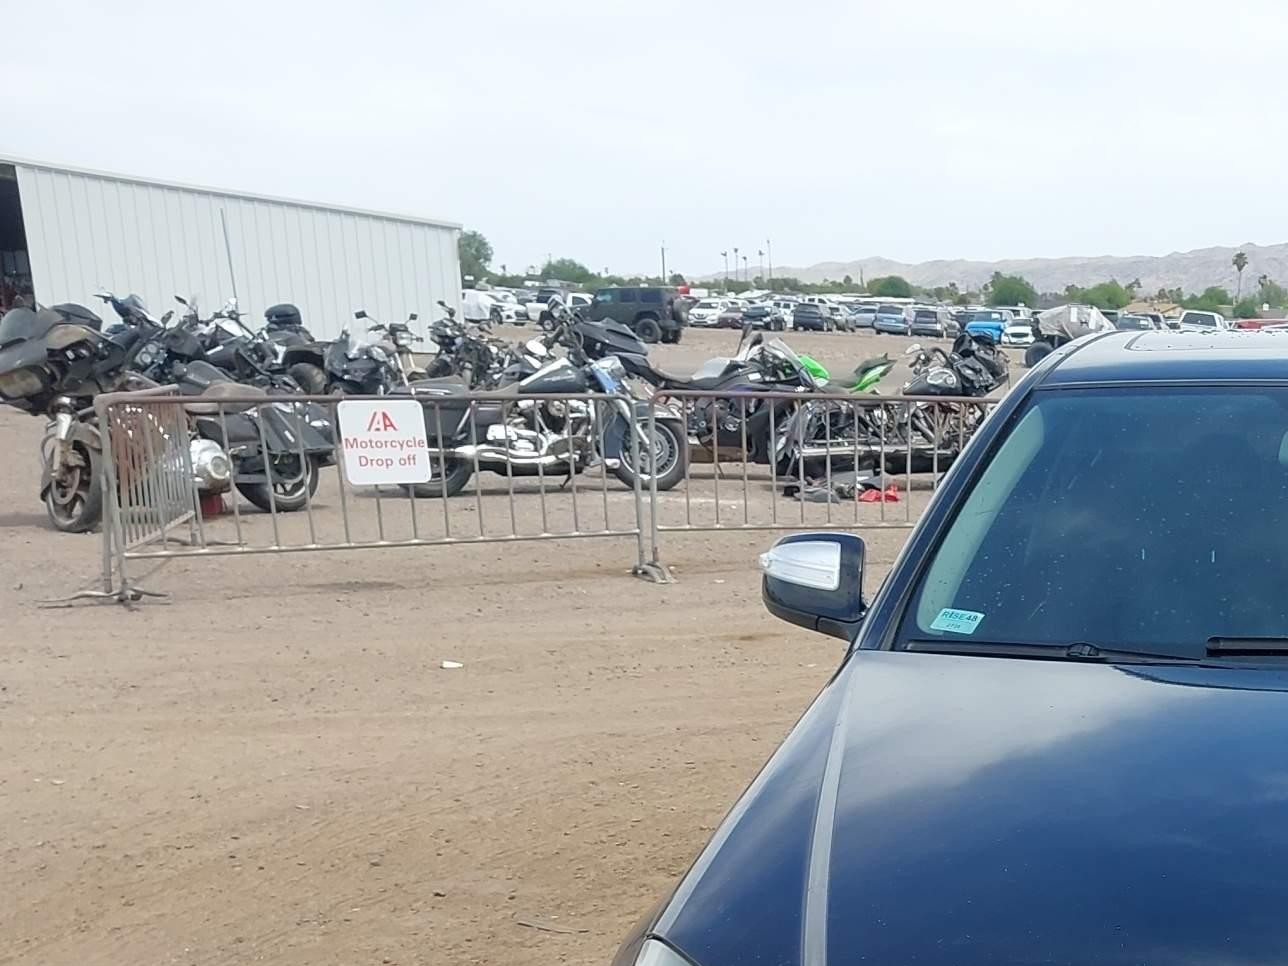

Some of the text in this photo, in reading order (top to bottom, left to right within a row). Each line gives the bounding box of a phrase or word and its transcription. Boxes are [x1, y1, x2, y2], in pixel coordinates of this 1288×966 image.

[345, 437, 425, 450] Motorcycle
[358, 455, 417, 469] Drop off
